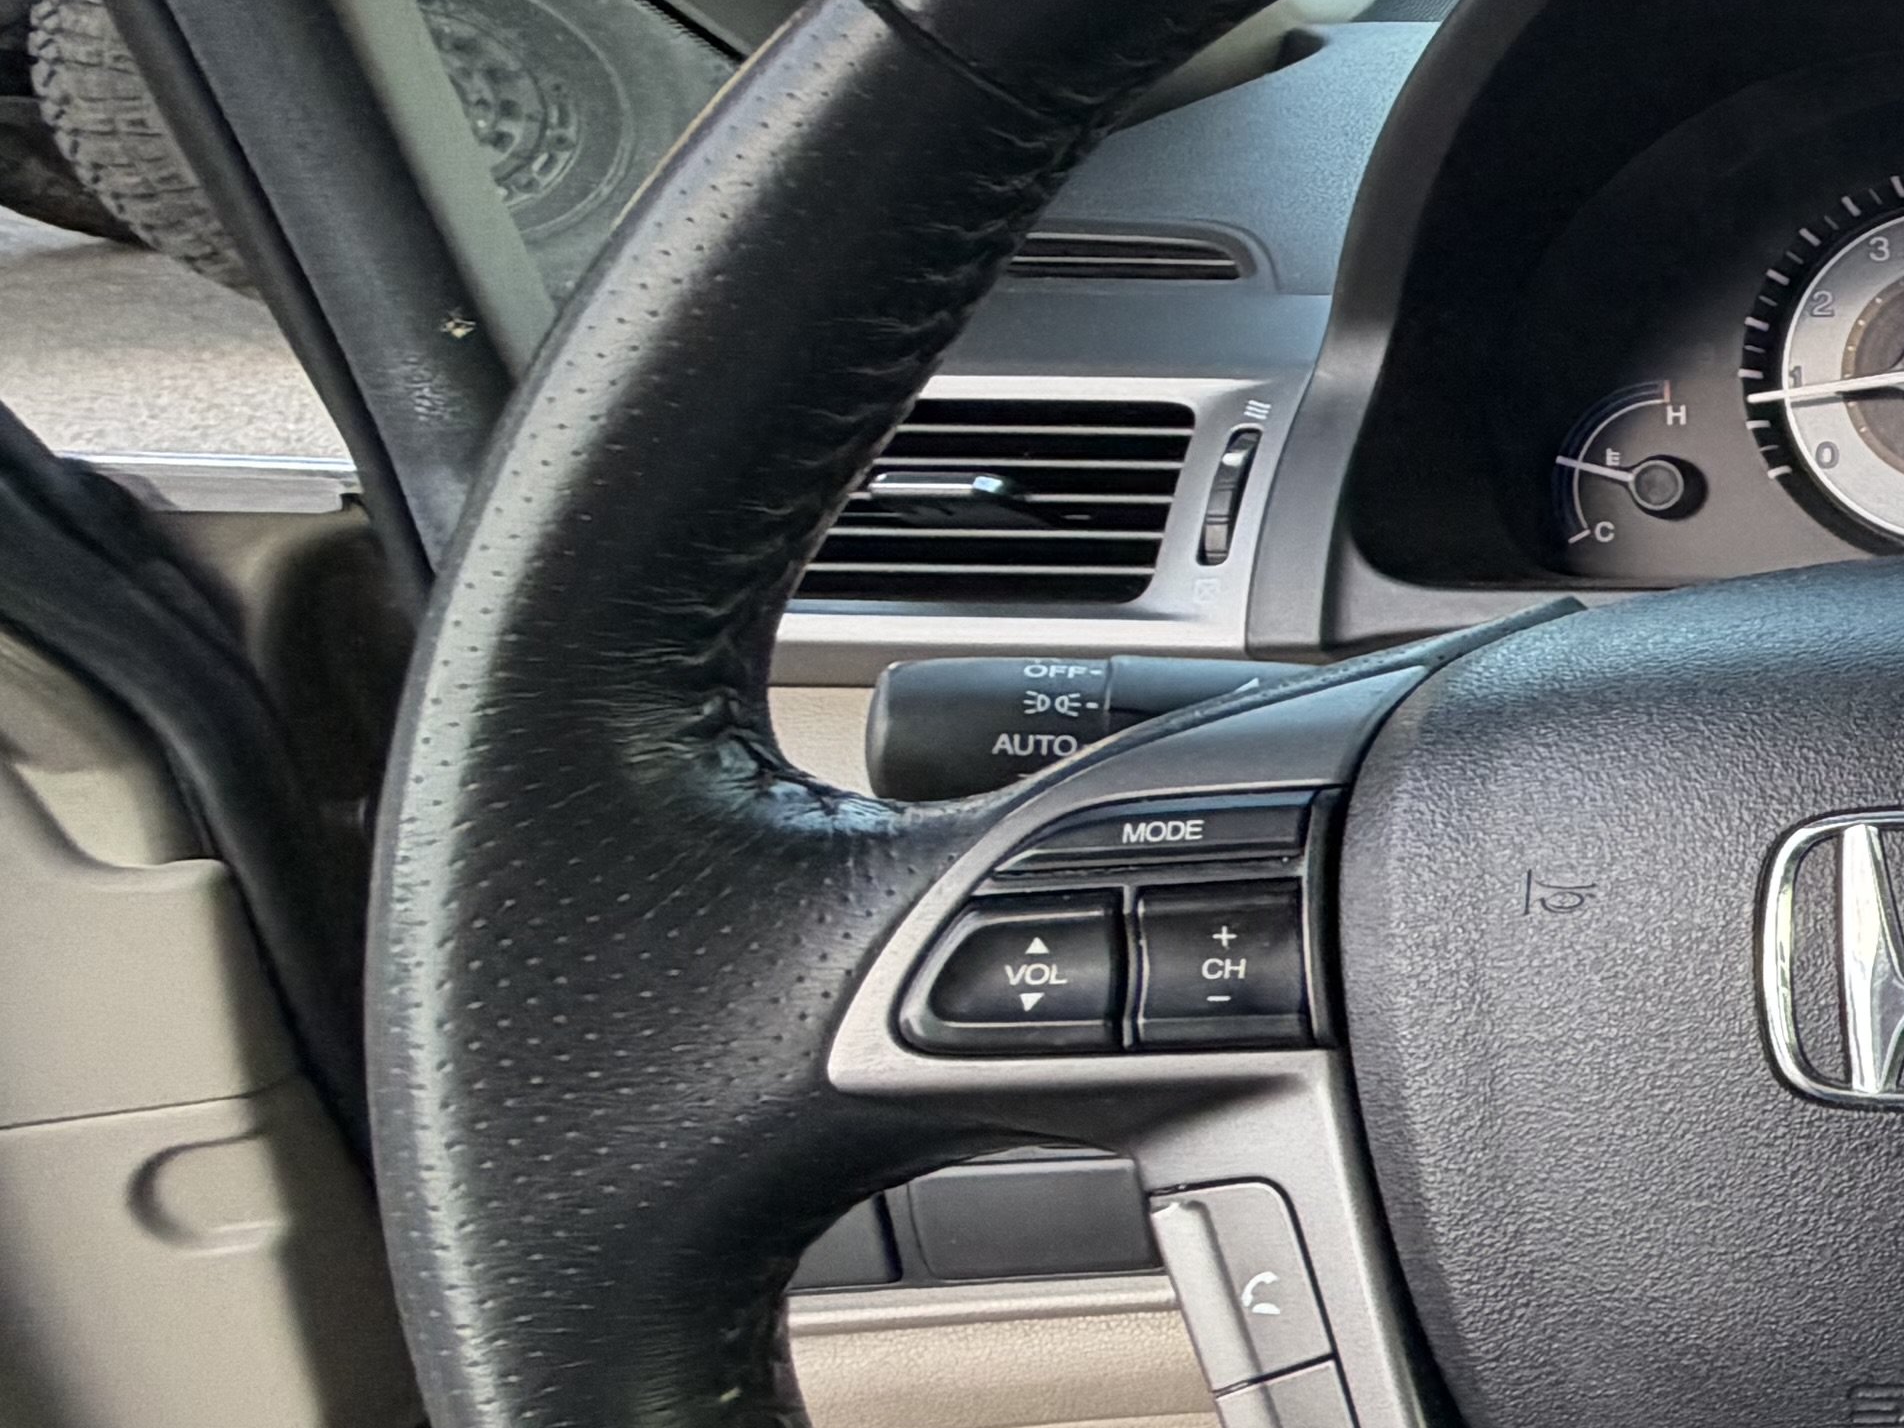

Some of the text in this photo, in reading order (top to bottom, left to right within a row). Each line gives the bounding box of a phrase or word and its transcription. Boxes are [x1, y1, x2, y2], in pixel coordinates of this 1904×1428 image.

[1869, 237, 1891, 262] 3
[1812, 291, 1834, 317] 2
[1666, 404, 1687, 426] H
[1815, 440, 1840, 470] 0
[1594, 521, 1615, 543] C
[1023, 663, 1088, 678] OFF
[992, 734, 1078, 756] AUTO
[1121, 819, 1205, 844] MODE
[1004, 962, 1069, 986] VOL
[1201, 956, 1247, 981] CH
